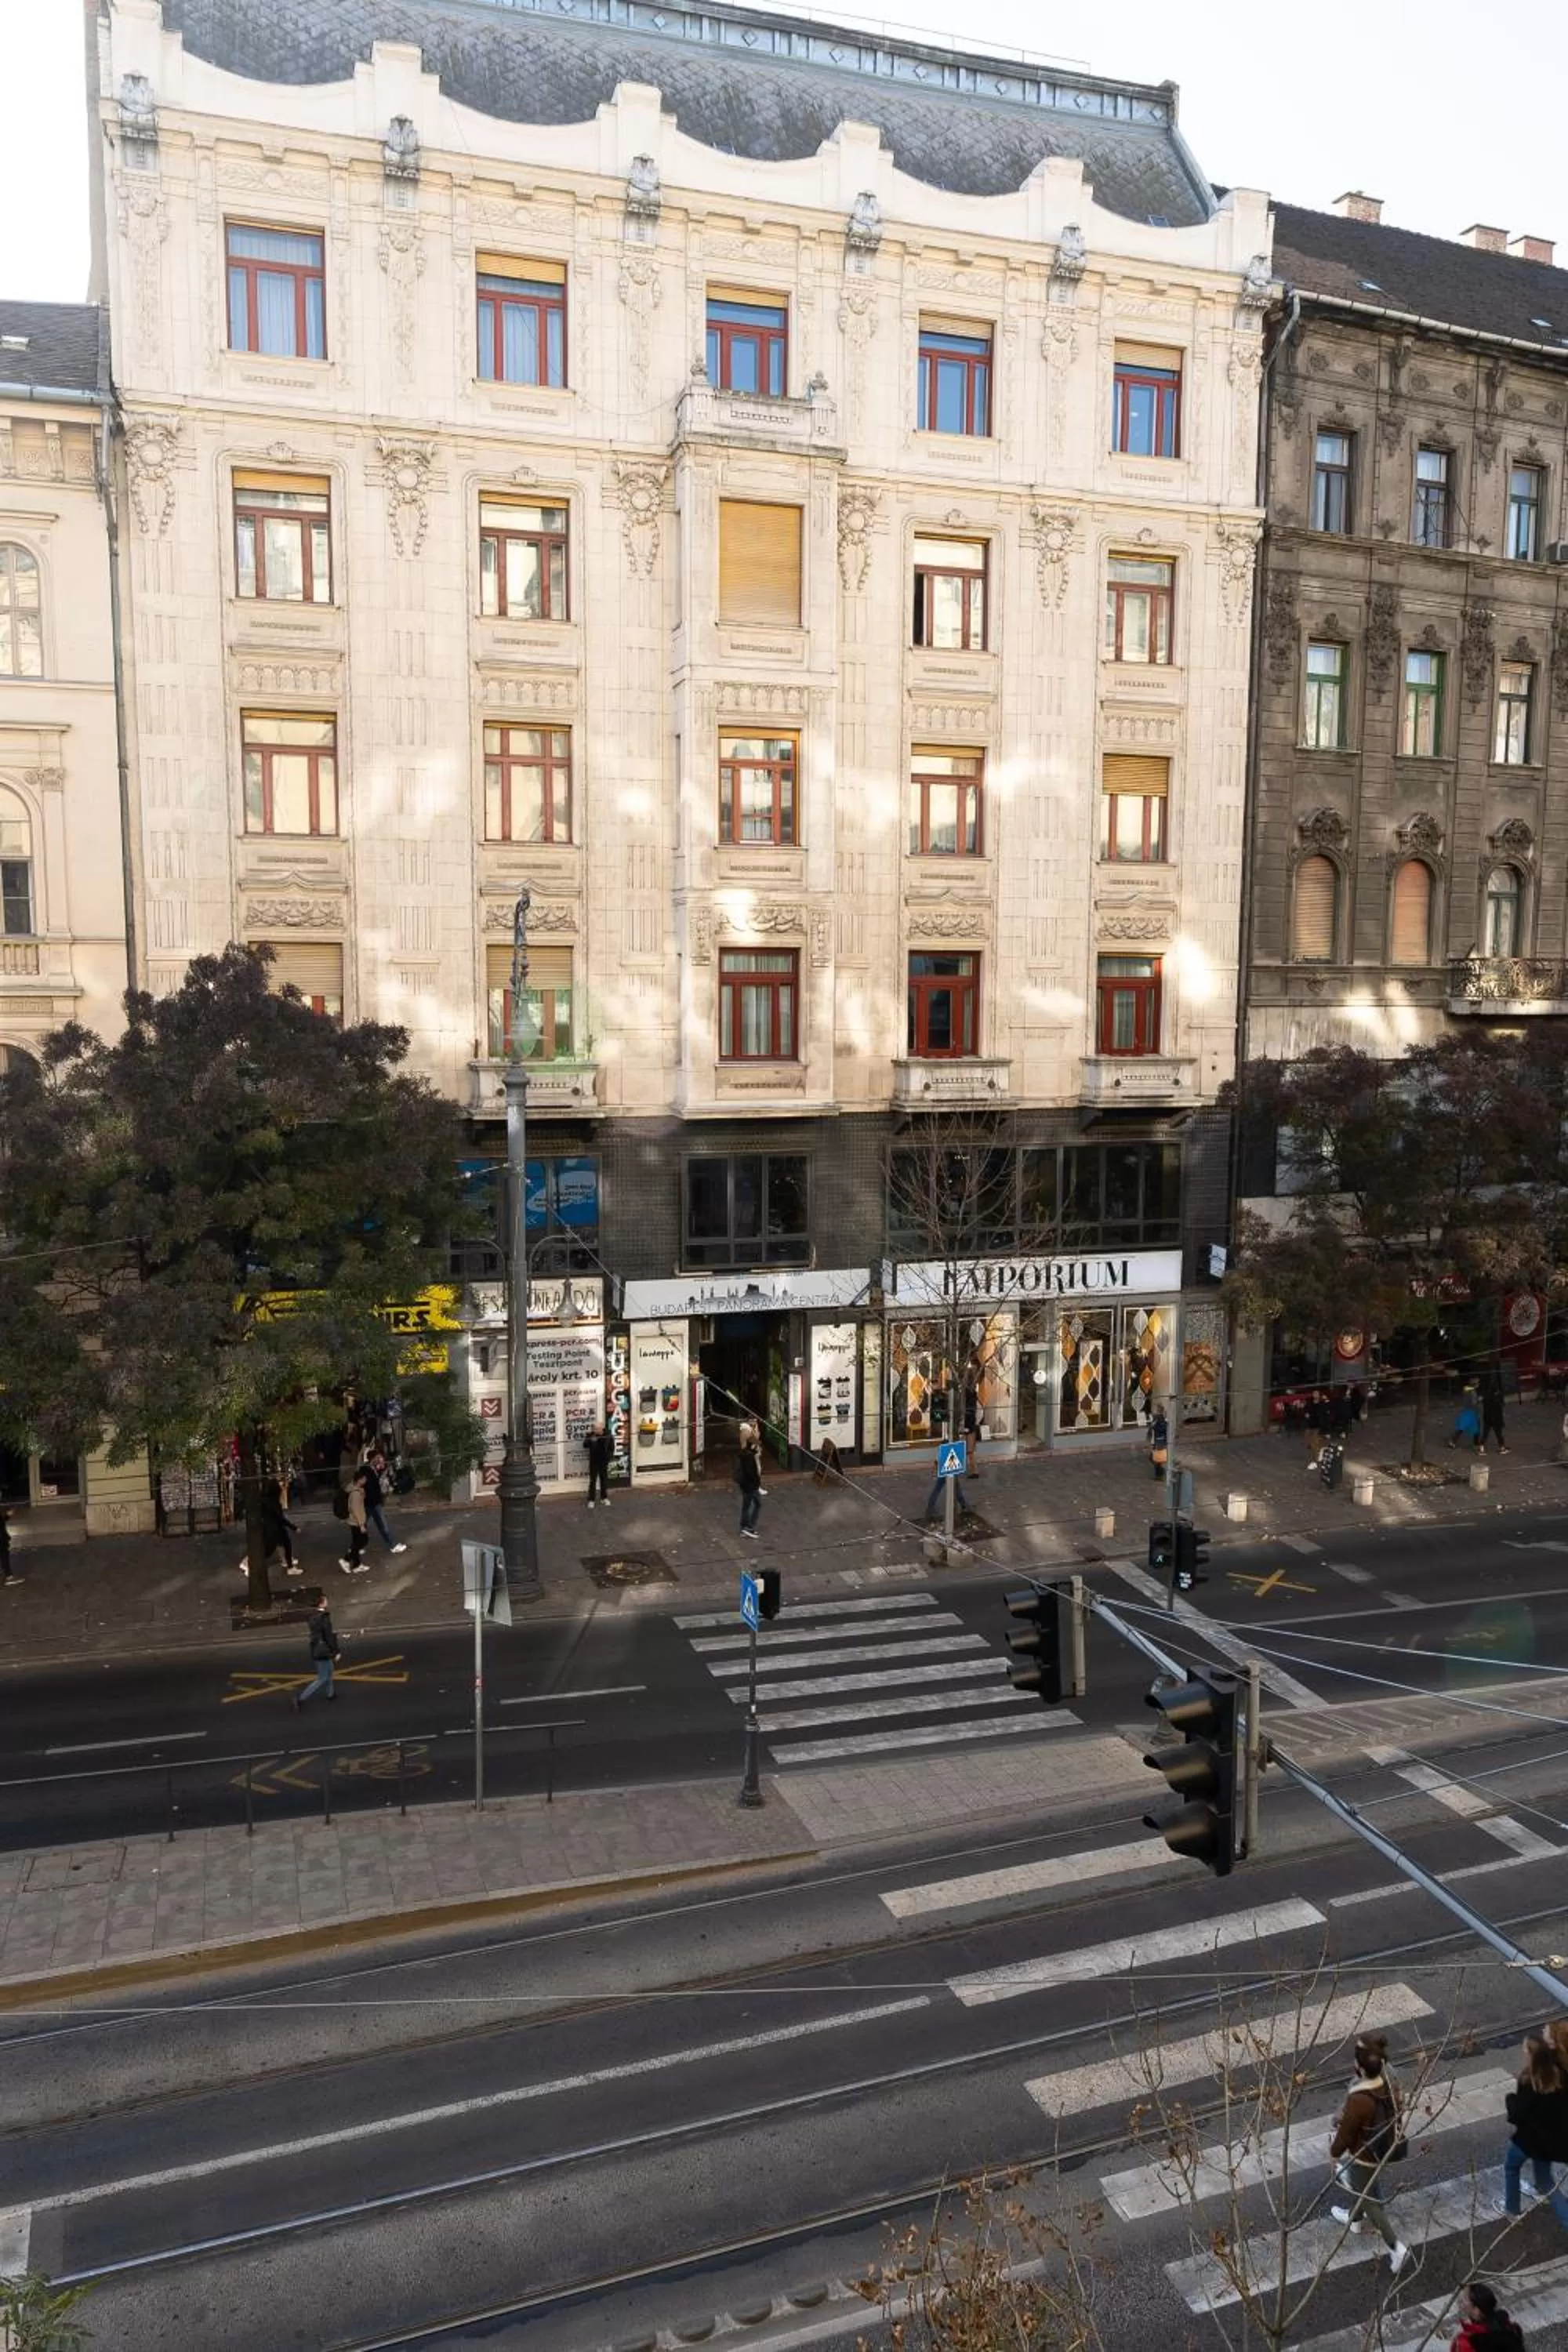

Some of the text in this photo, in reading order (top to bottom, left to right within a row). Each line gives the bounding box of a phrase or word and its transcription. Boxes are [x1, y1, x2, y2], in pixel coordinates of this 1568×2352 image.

[649, 1294, 843, 1316] BUDAPEST PANORAMA CENTRAL
[564, 1349, 590, 1358] Point
[528, 1370, 598, 1383] ároly krt. 10
[611, 1336, 625, 1456] LUGGAGE
